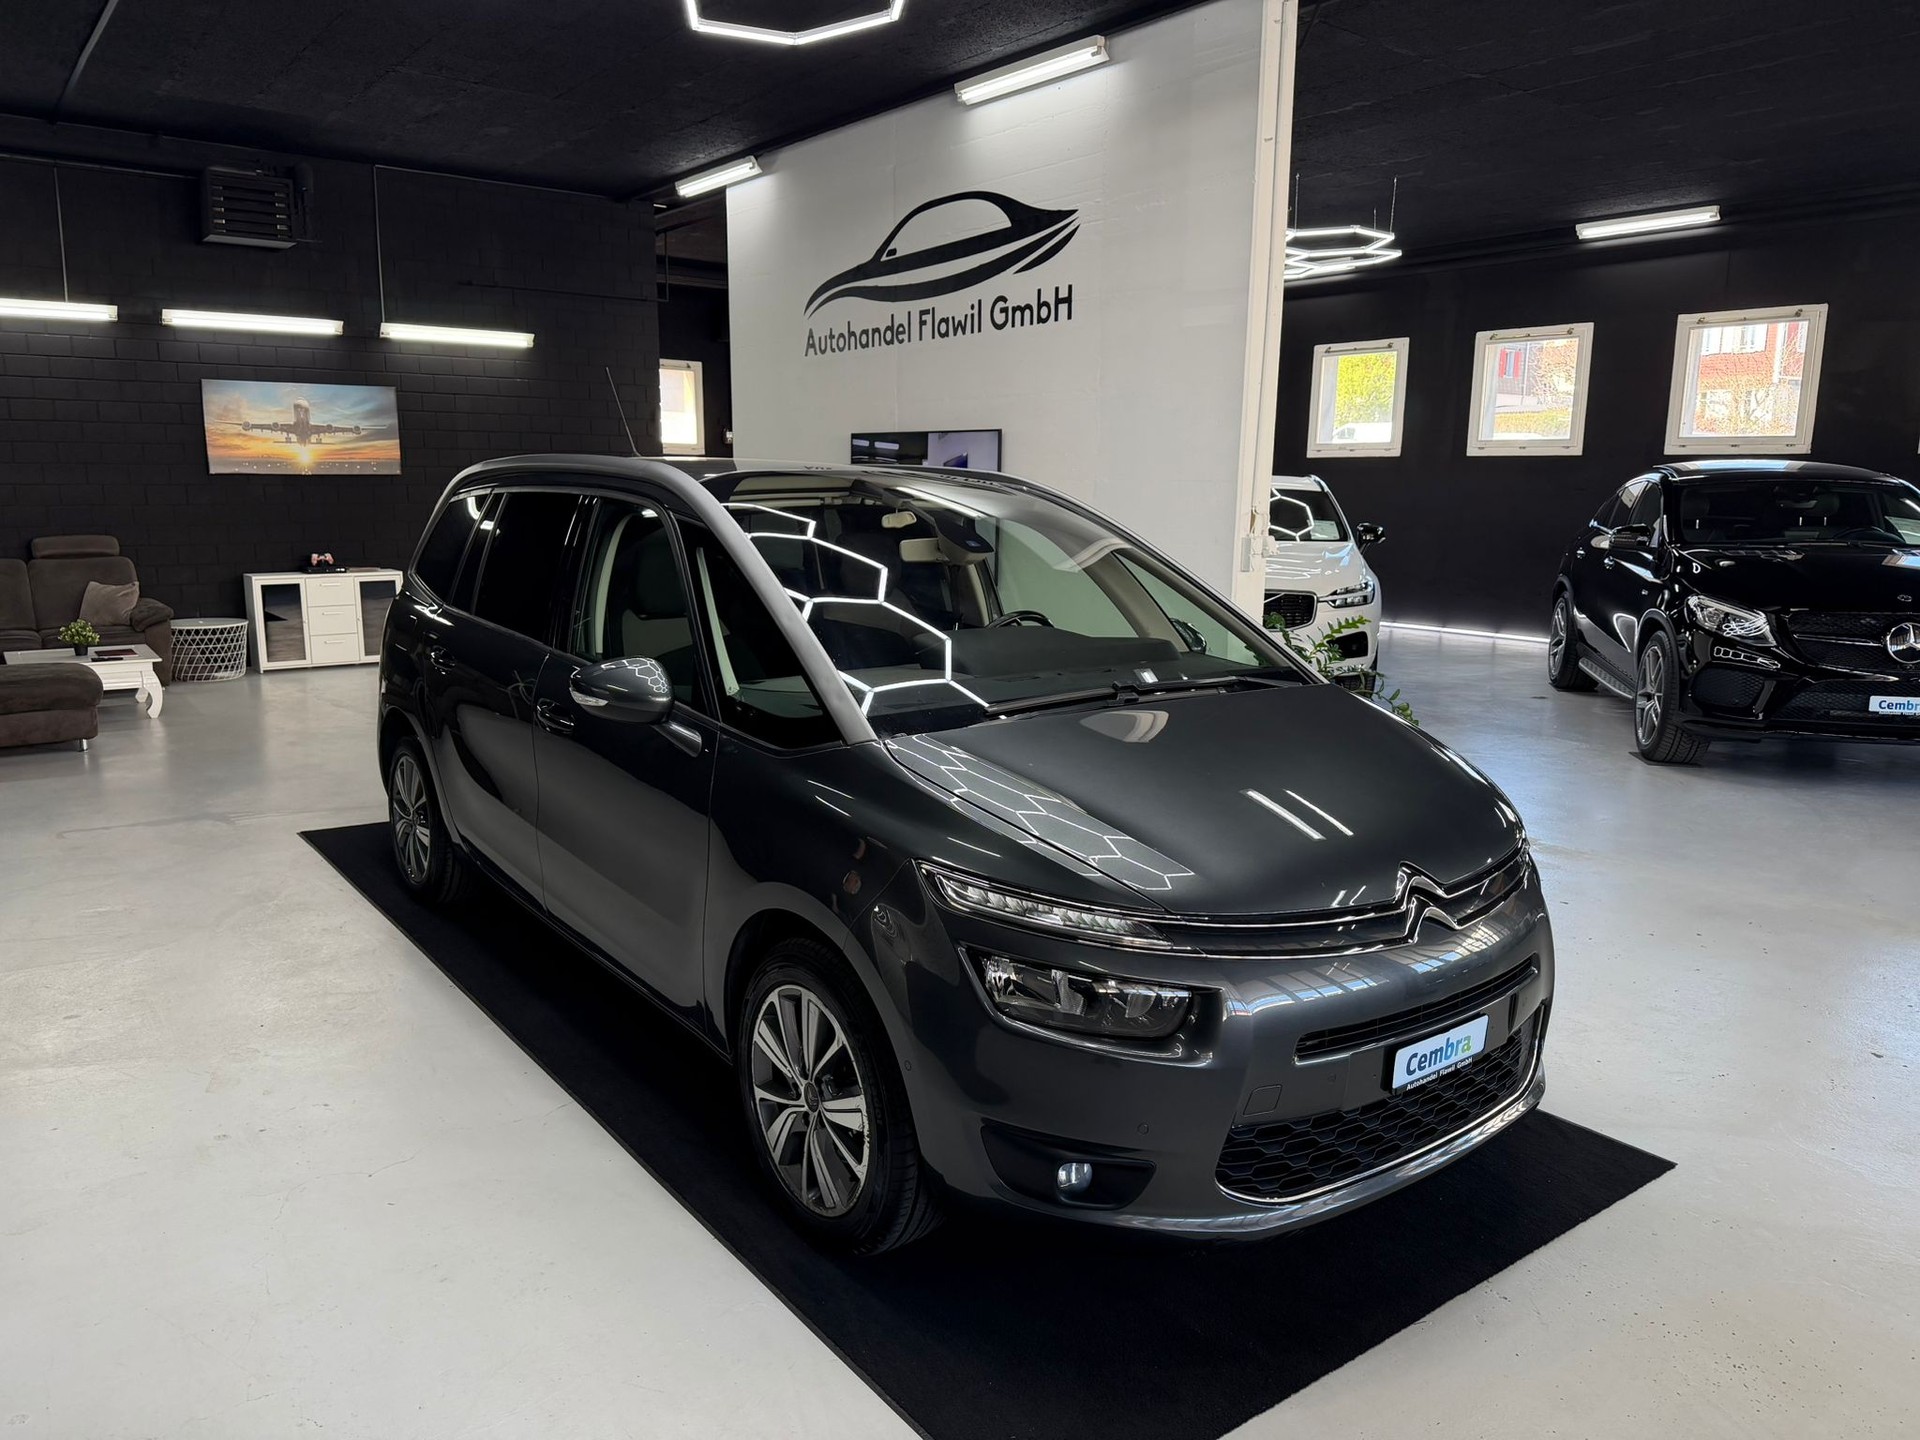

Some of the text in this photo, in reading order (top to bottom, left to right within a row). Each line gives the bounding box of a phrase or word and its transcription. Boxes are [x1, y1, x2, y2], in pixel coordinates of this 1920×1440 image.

[804, 284, 1073, 357] Autohandel Flawil GmbH
[1878, 700, 1920, 711] Cembr
[1406, 1035, 1472, 1076] Cembra
[1406, 1072, 1437, 1091] Autohandel
